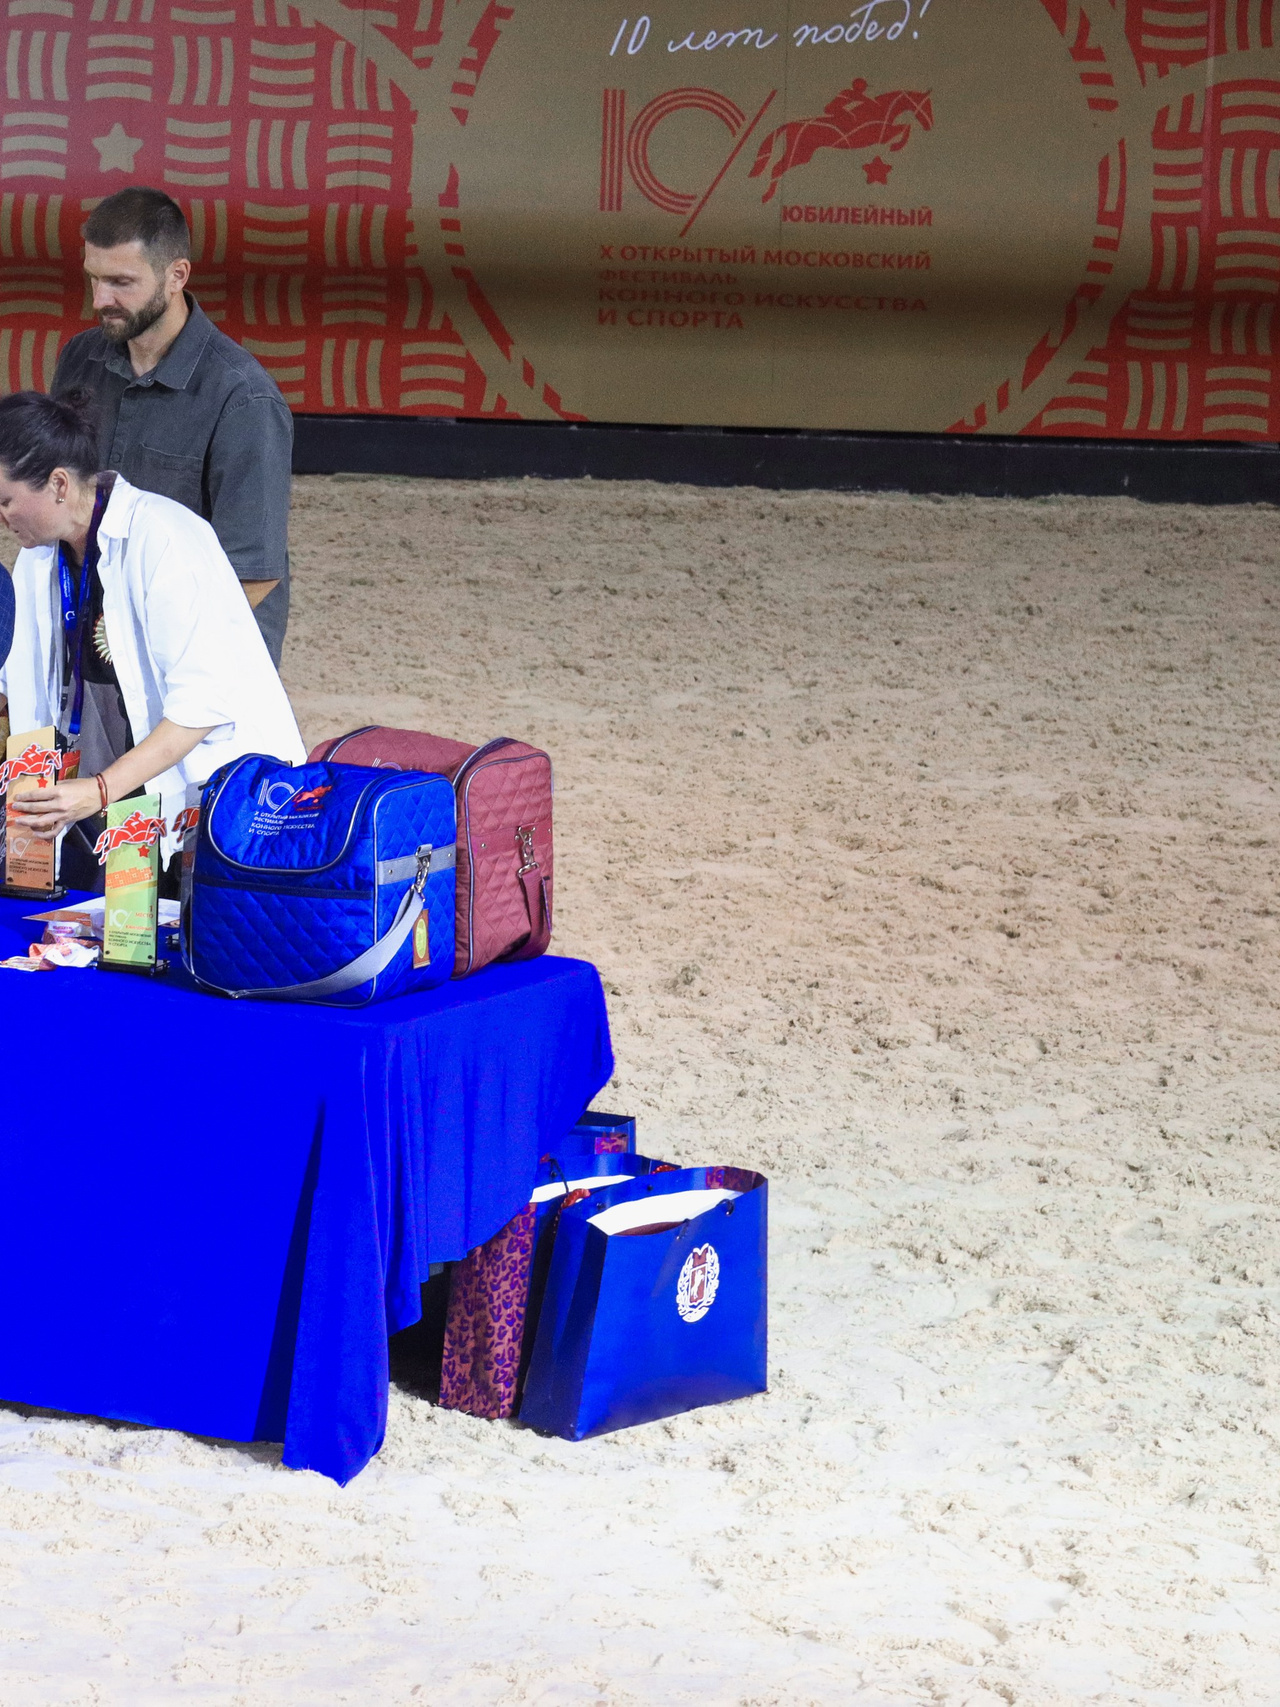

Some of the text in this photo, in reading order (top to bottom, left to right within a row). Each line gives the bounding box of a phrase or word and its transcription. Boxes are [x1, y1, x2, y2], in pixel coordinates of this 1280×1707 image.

[609, 16, 651, 56] 10
[668, 28, 778, 53] лет
[781, 204, 933, 227] ЮБИЛЕЙНЫЙ
[619, 243, 757, 265] ОТКРЫТЫЙ
[763, 249, 932, 270] МОСКОВСКИЙ
[598, 268, 738, 286] ФЕСТИВАЛЬ
[597, 287, 928, 312] КОННОГО ИСКУССТВА
[597, 307, 744, 329] И СПОРТА
